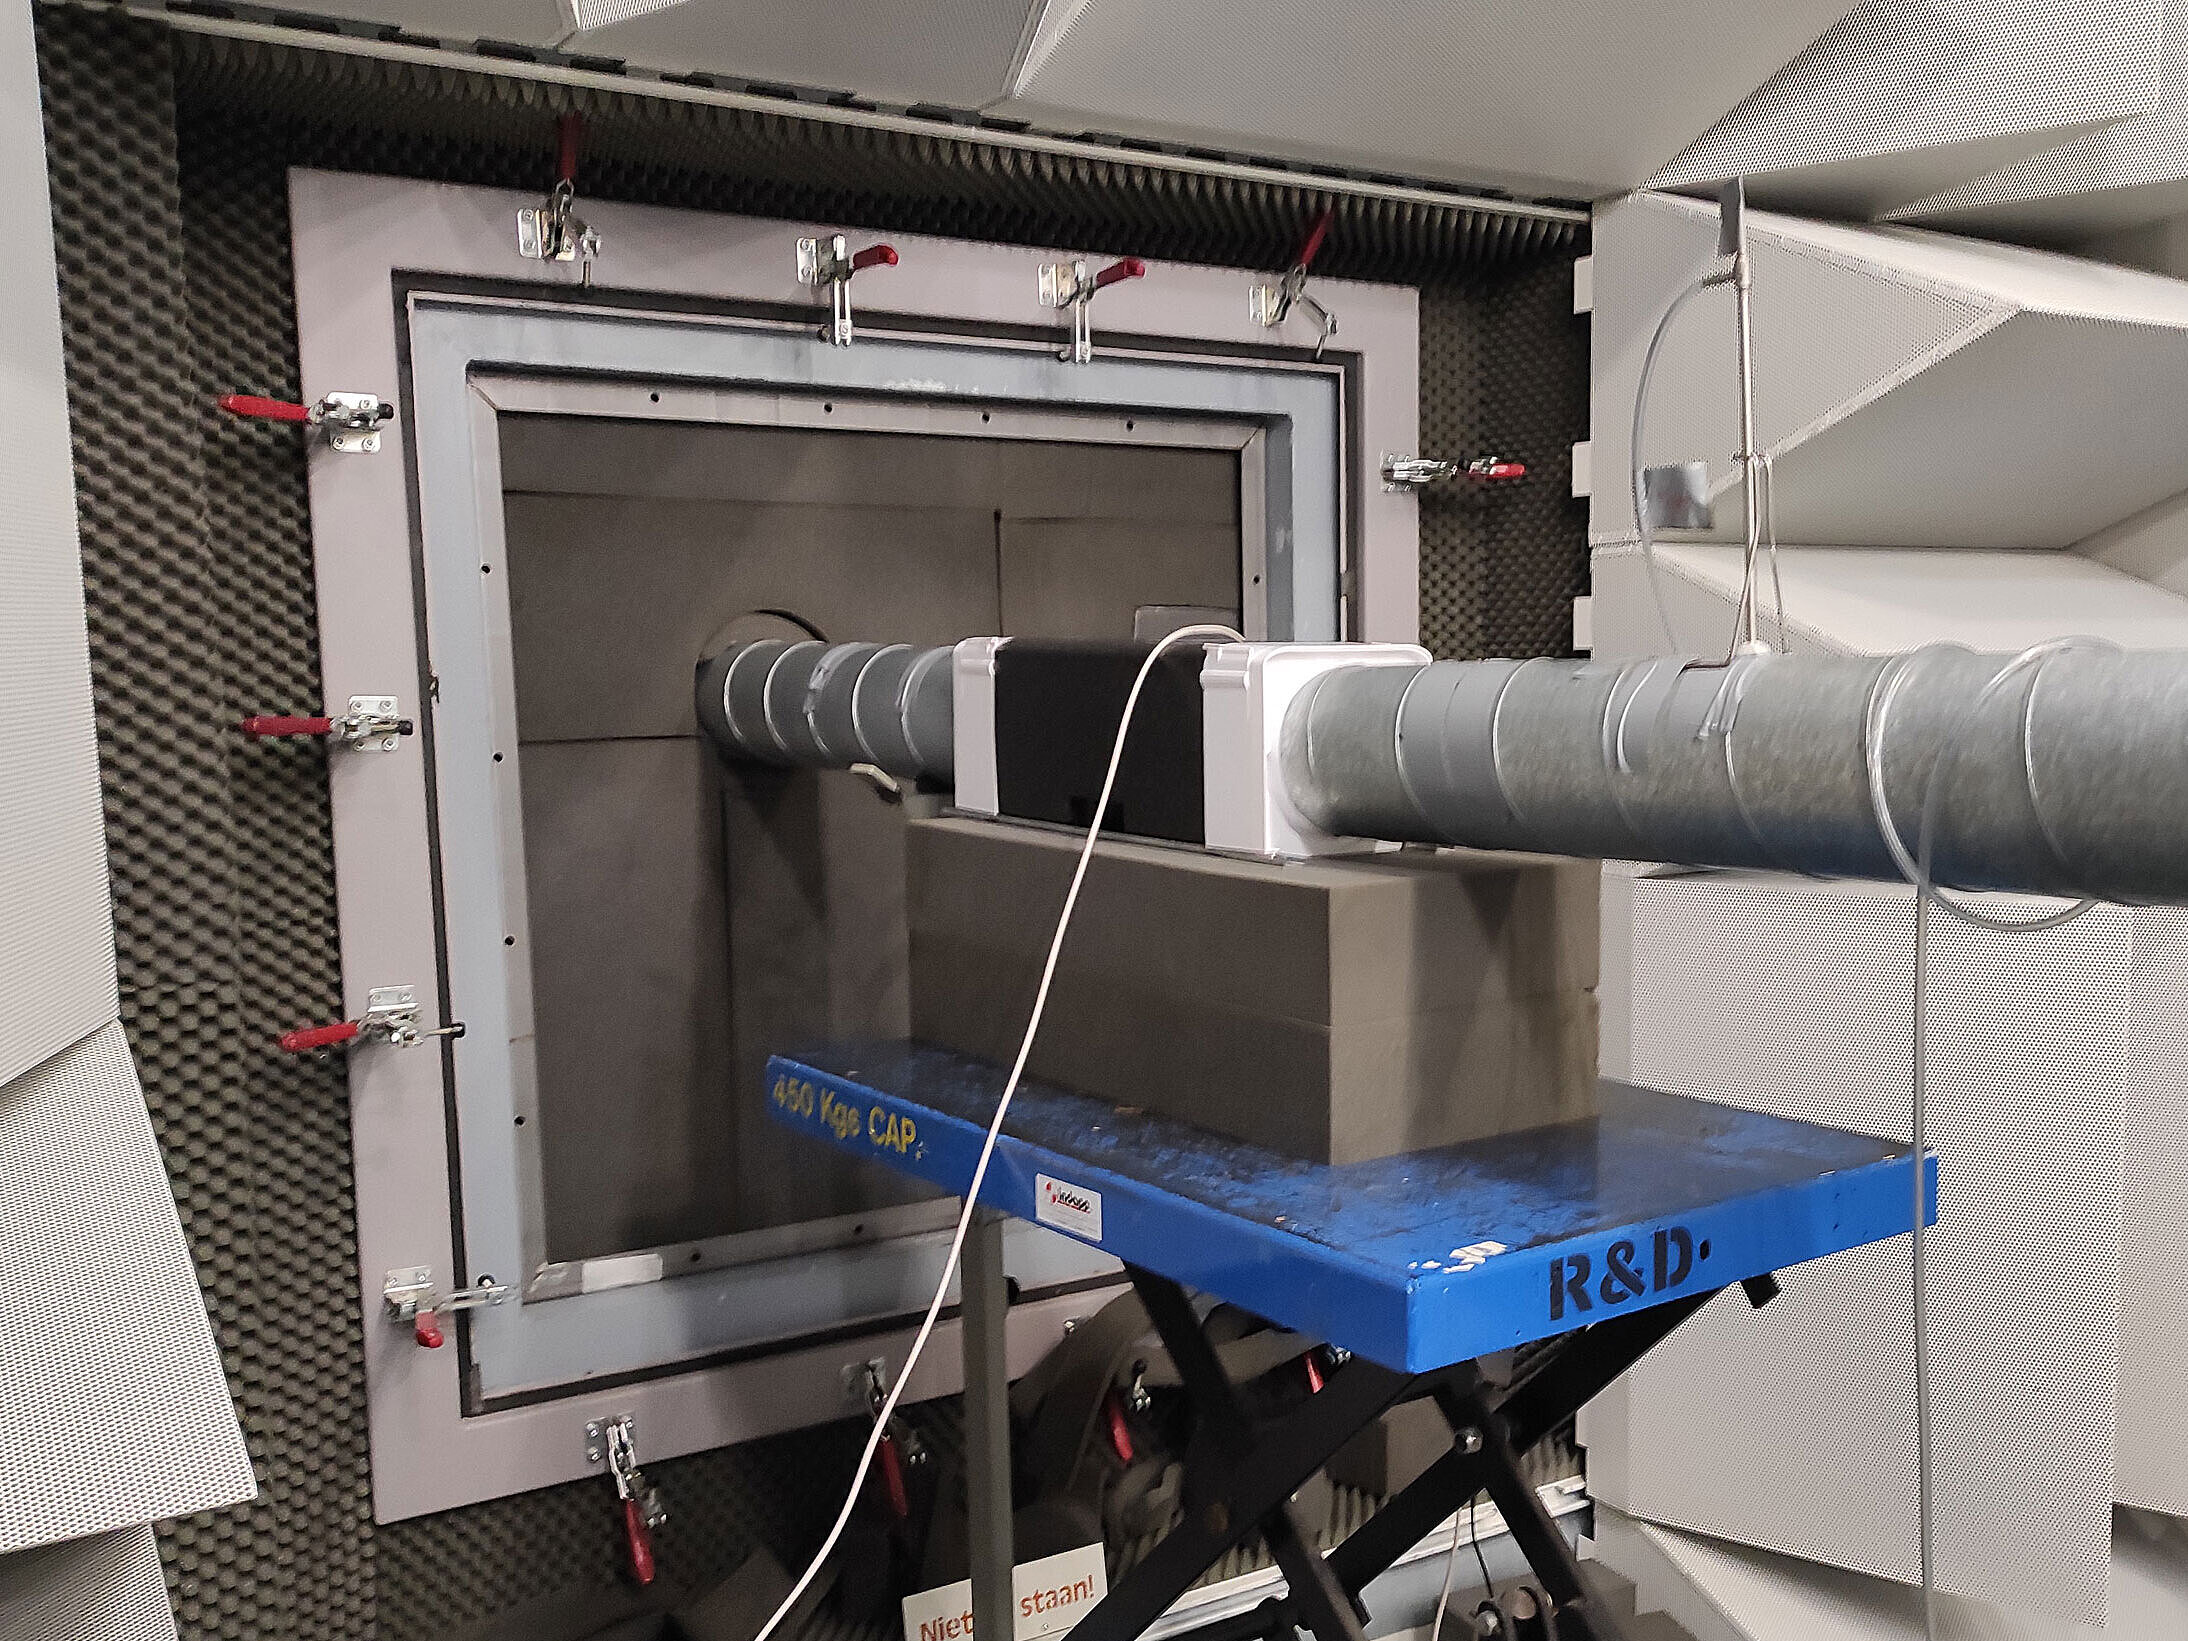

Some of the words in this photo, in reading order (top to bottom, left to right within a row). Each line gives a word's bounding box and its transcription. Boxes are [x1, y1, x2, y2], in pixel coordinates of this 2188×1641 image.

[773, 1074, 814, 1118] 450
[820, 1088, 861, 1139] Kgs
[920, 1610, 974, 1641] Niet
[1020, 1574, 1095, 1618] staan!
